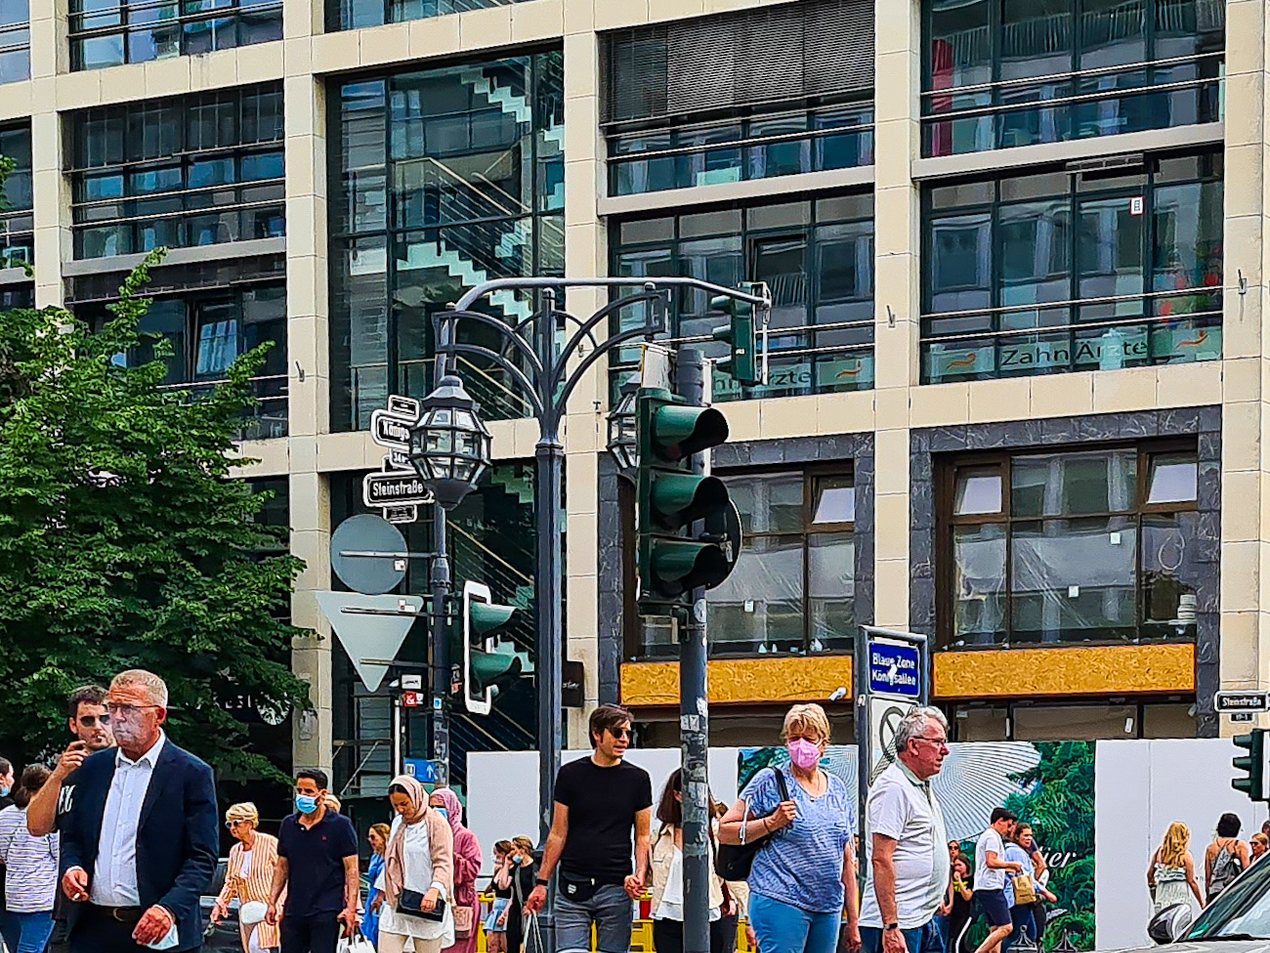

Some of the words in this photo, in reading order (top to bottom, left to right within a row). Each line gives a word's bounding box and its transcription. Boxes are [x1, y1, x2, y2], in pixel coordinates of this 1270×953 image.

[1001, 346, 1069, 366] Zahn
[373, 480, 424, 497] Steinstraße
[896, 654, 916, 669] Zone
[871, 668, 917, 686] Könisallee
